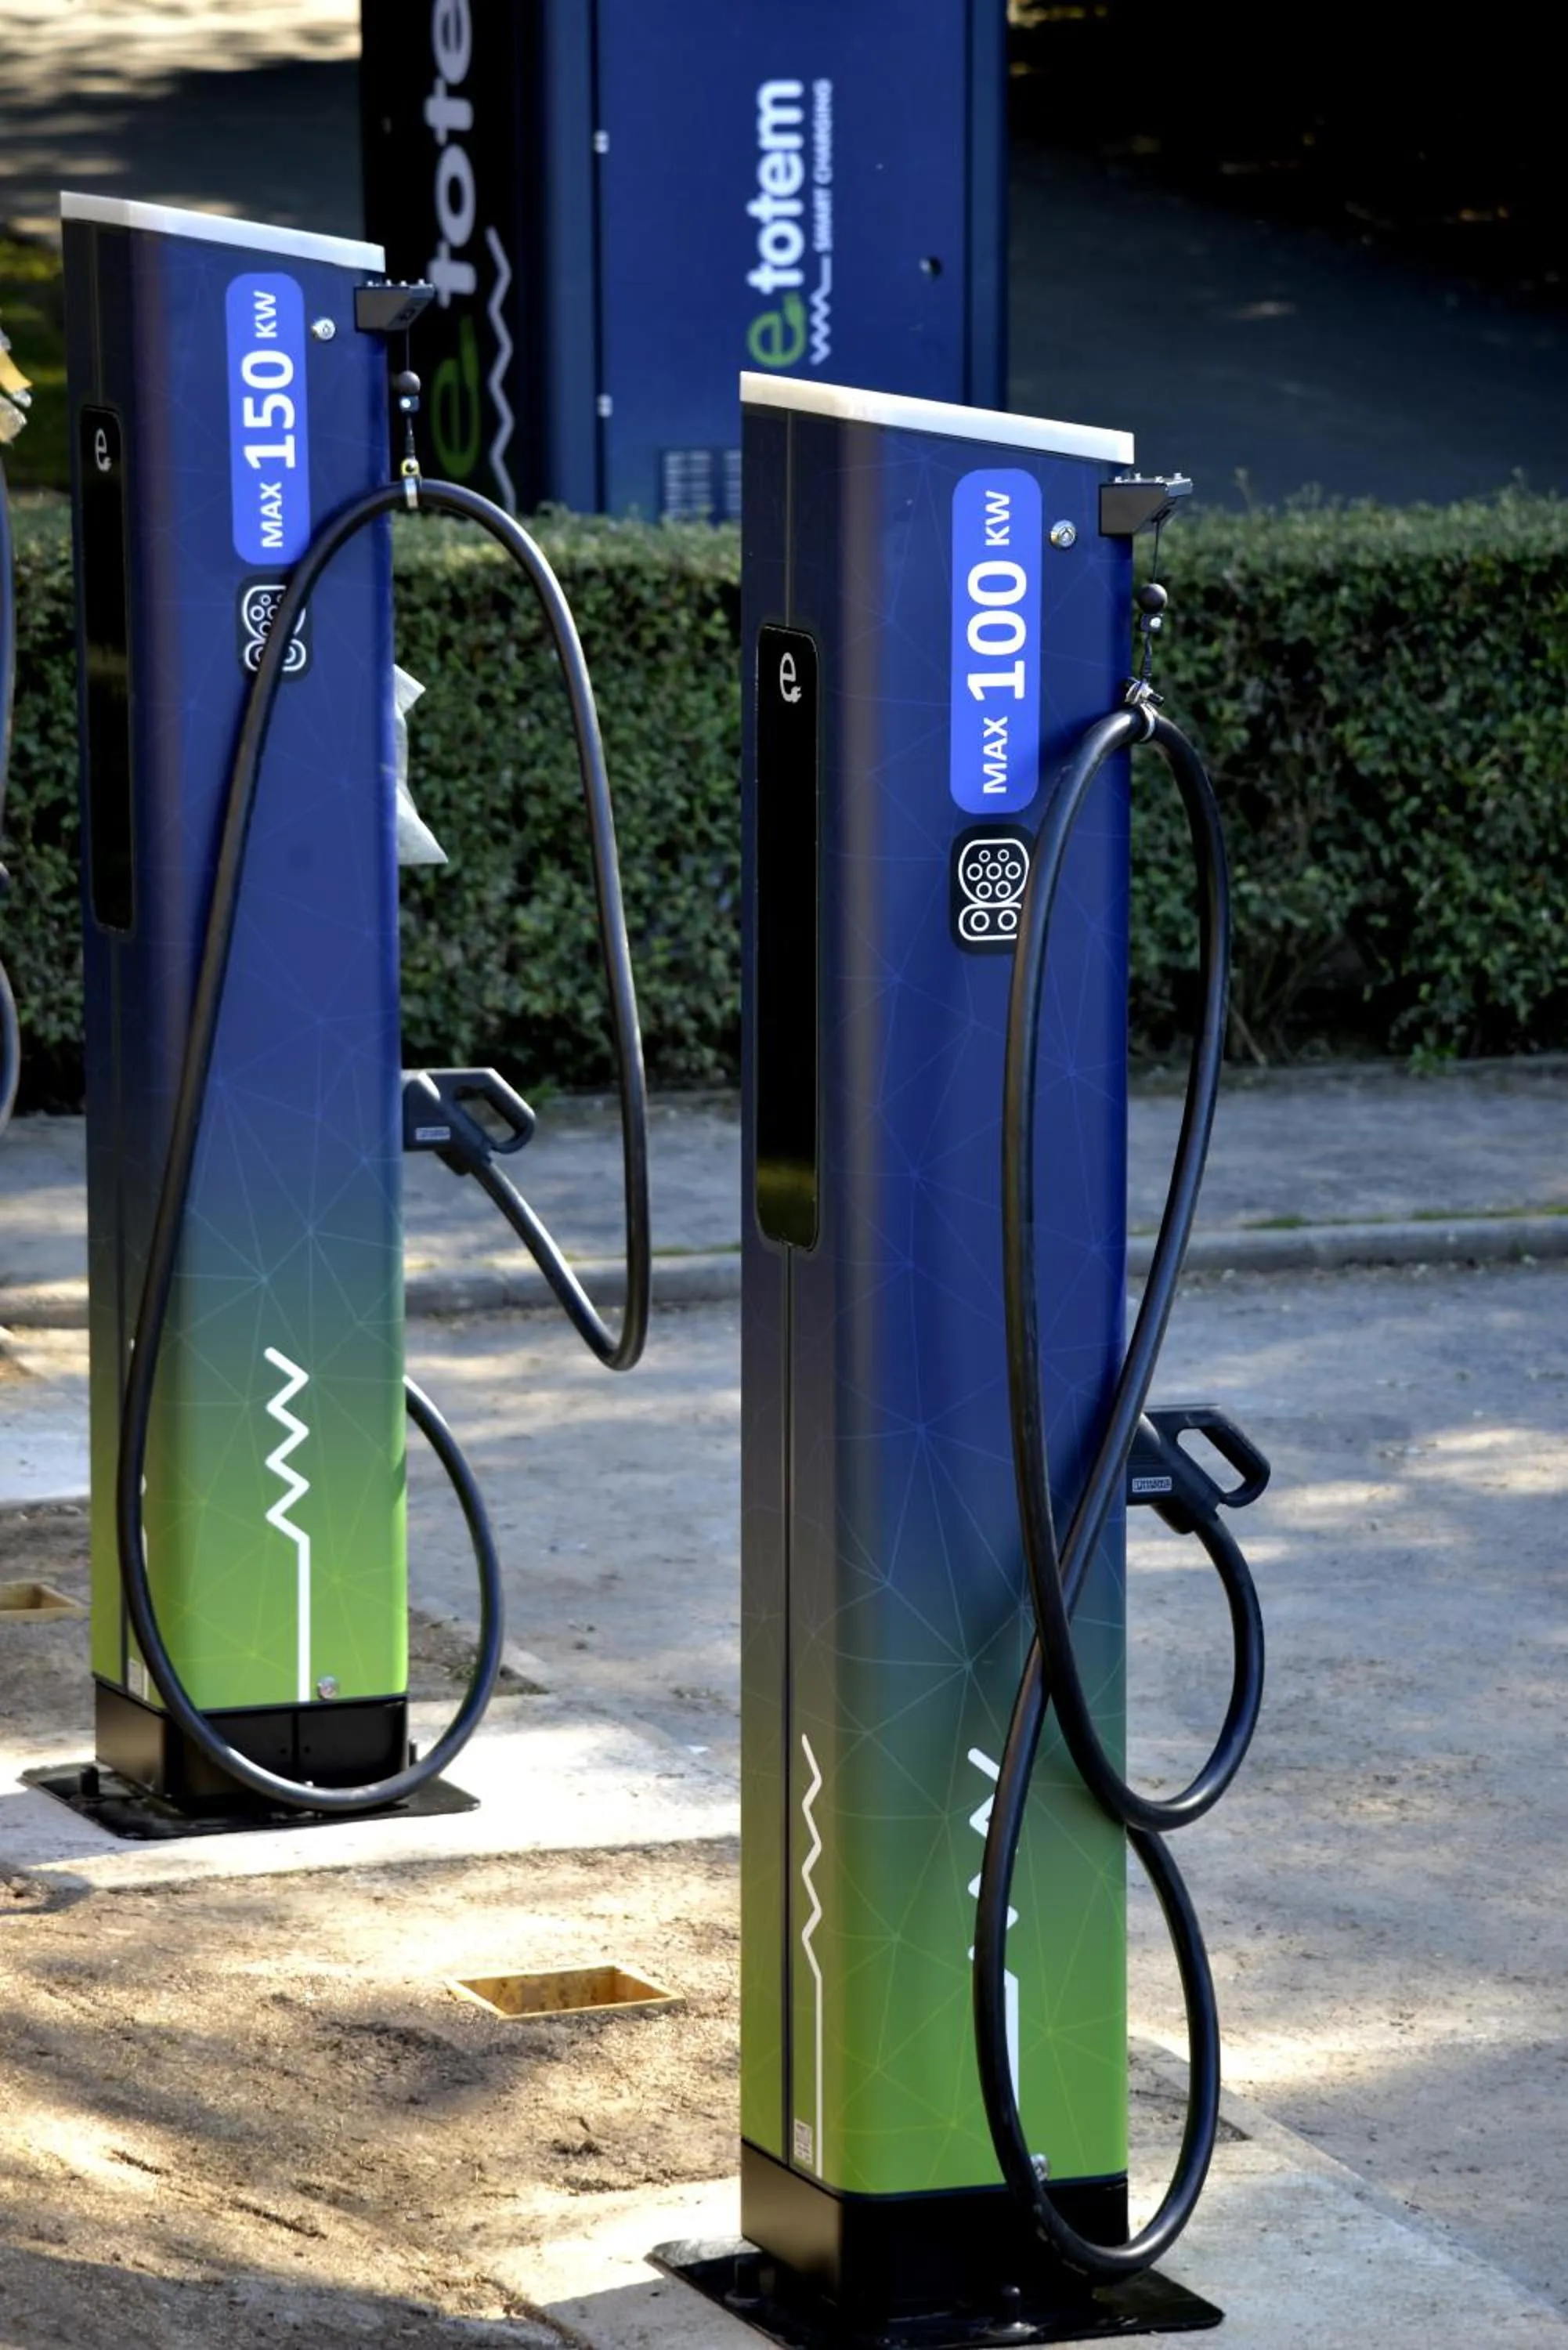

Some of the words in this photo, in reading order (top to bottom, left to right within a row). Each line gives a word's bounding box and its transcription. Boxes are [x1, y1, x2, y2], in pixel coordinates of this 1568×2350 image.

[811, 78, 833, 185] CHARGING
[811, 188, 833, 253] SMART
[252, 289, 278, 339] KW
[241, 349, 296, 470] 150
[259, 482, 284, 548] MAX
[985, 490, 1010, 547] KW
[966, 560, 1028, 702] 100
[982, 716, 1009, 794] MAX
